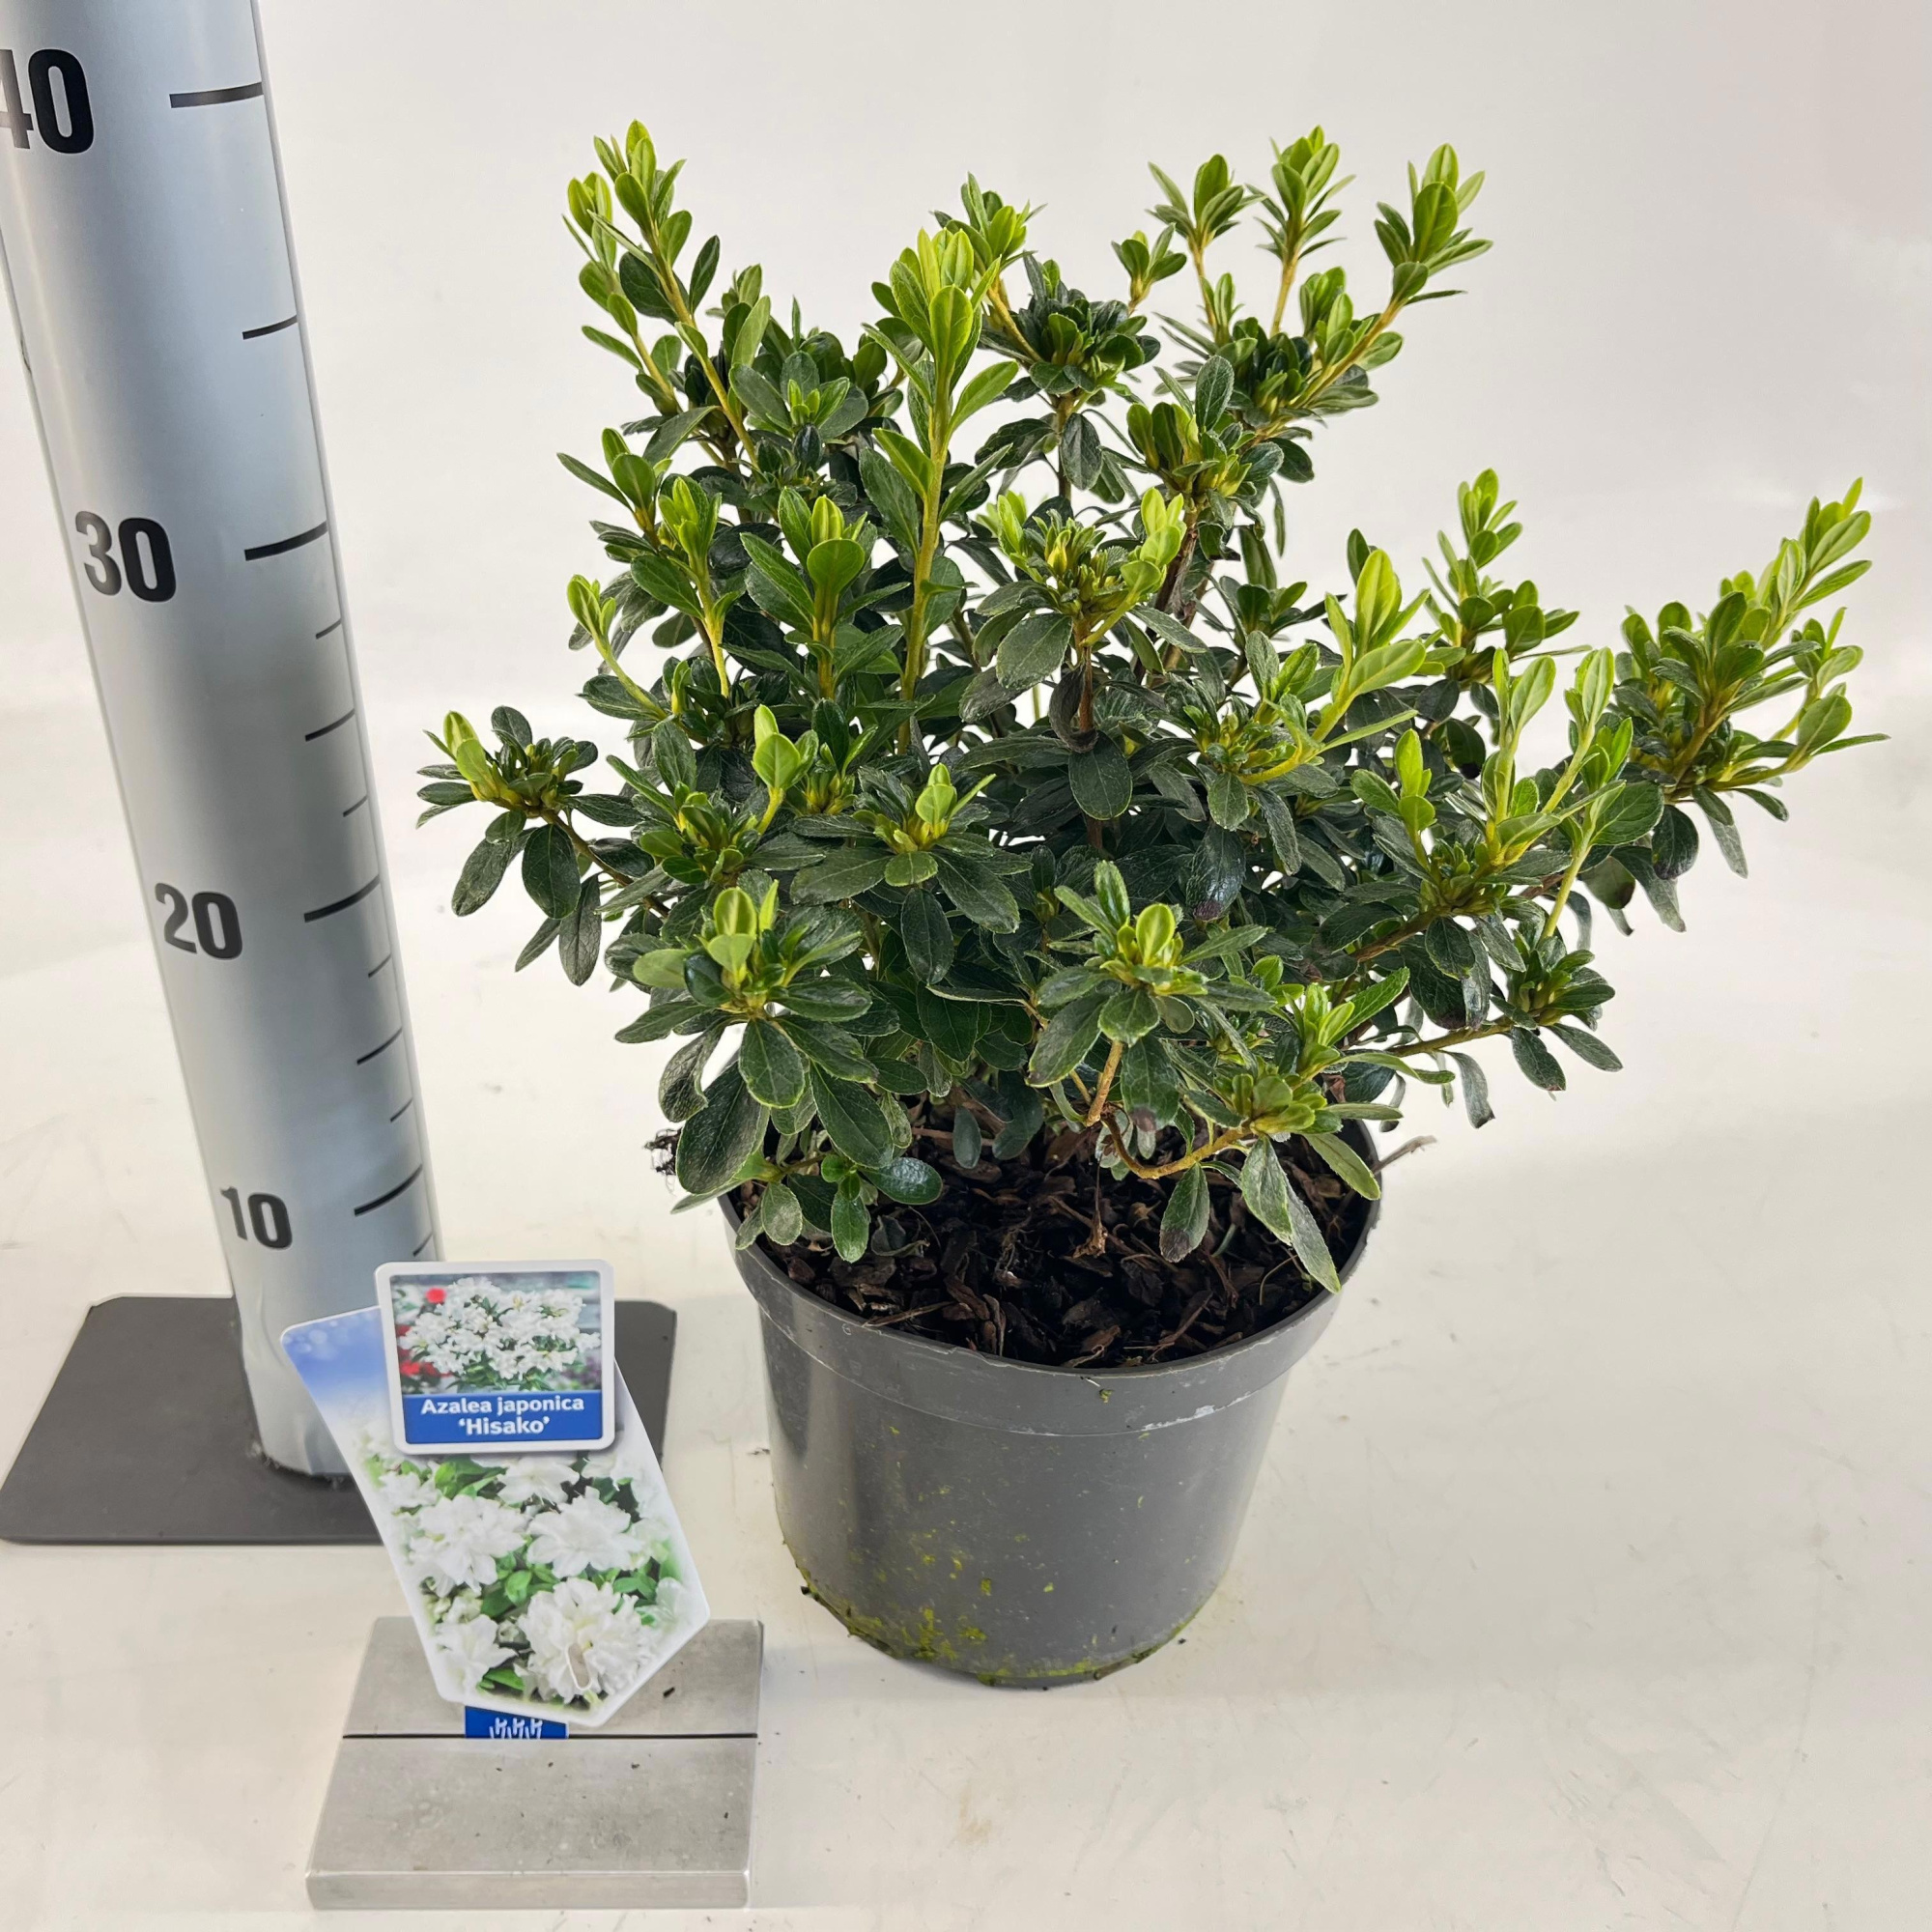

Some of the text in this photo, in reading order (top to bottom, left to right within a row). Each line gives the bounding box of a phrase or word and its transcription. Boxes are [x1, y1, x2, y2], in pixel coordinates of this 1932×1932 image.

[75, 510, 177, 603] 30
[155, 882, 243, 960] 20
[220, 1185, 294, 1250] 10
[420, 1395, 585, 1417] Azalea japonica
[458, 1415, 551, 1436] ‘Hisako’
